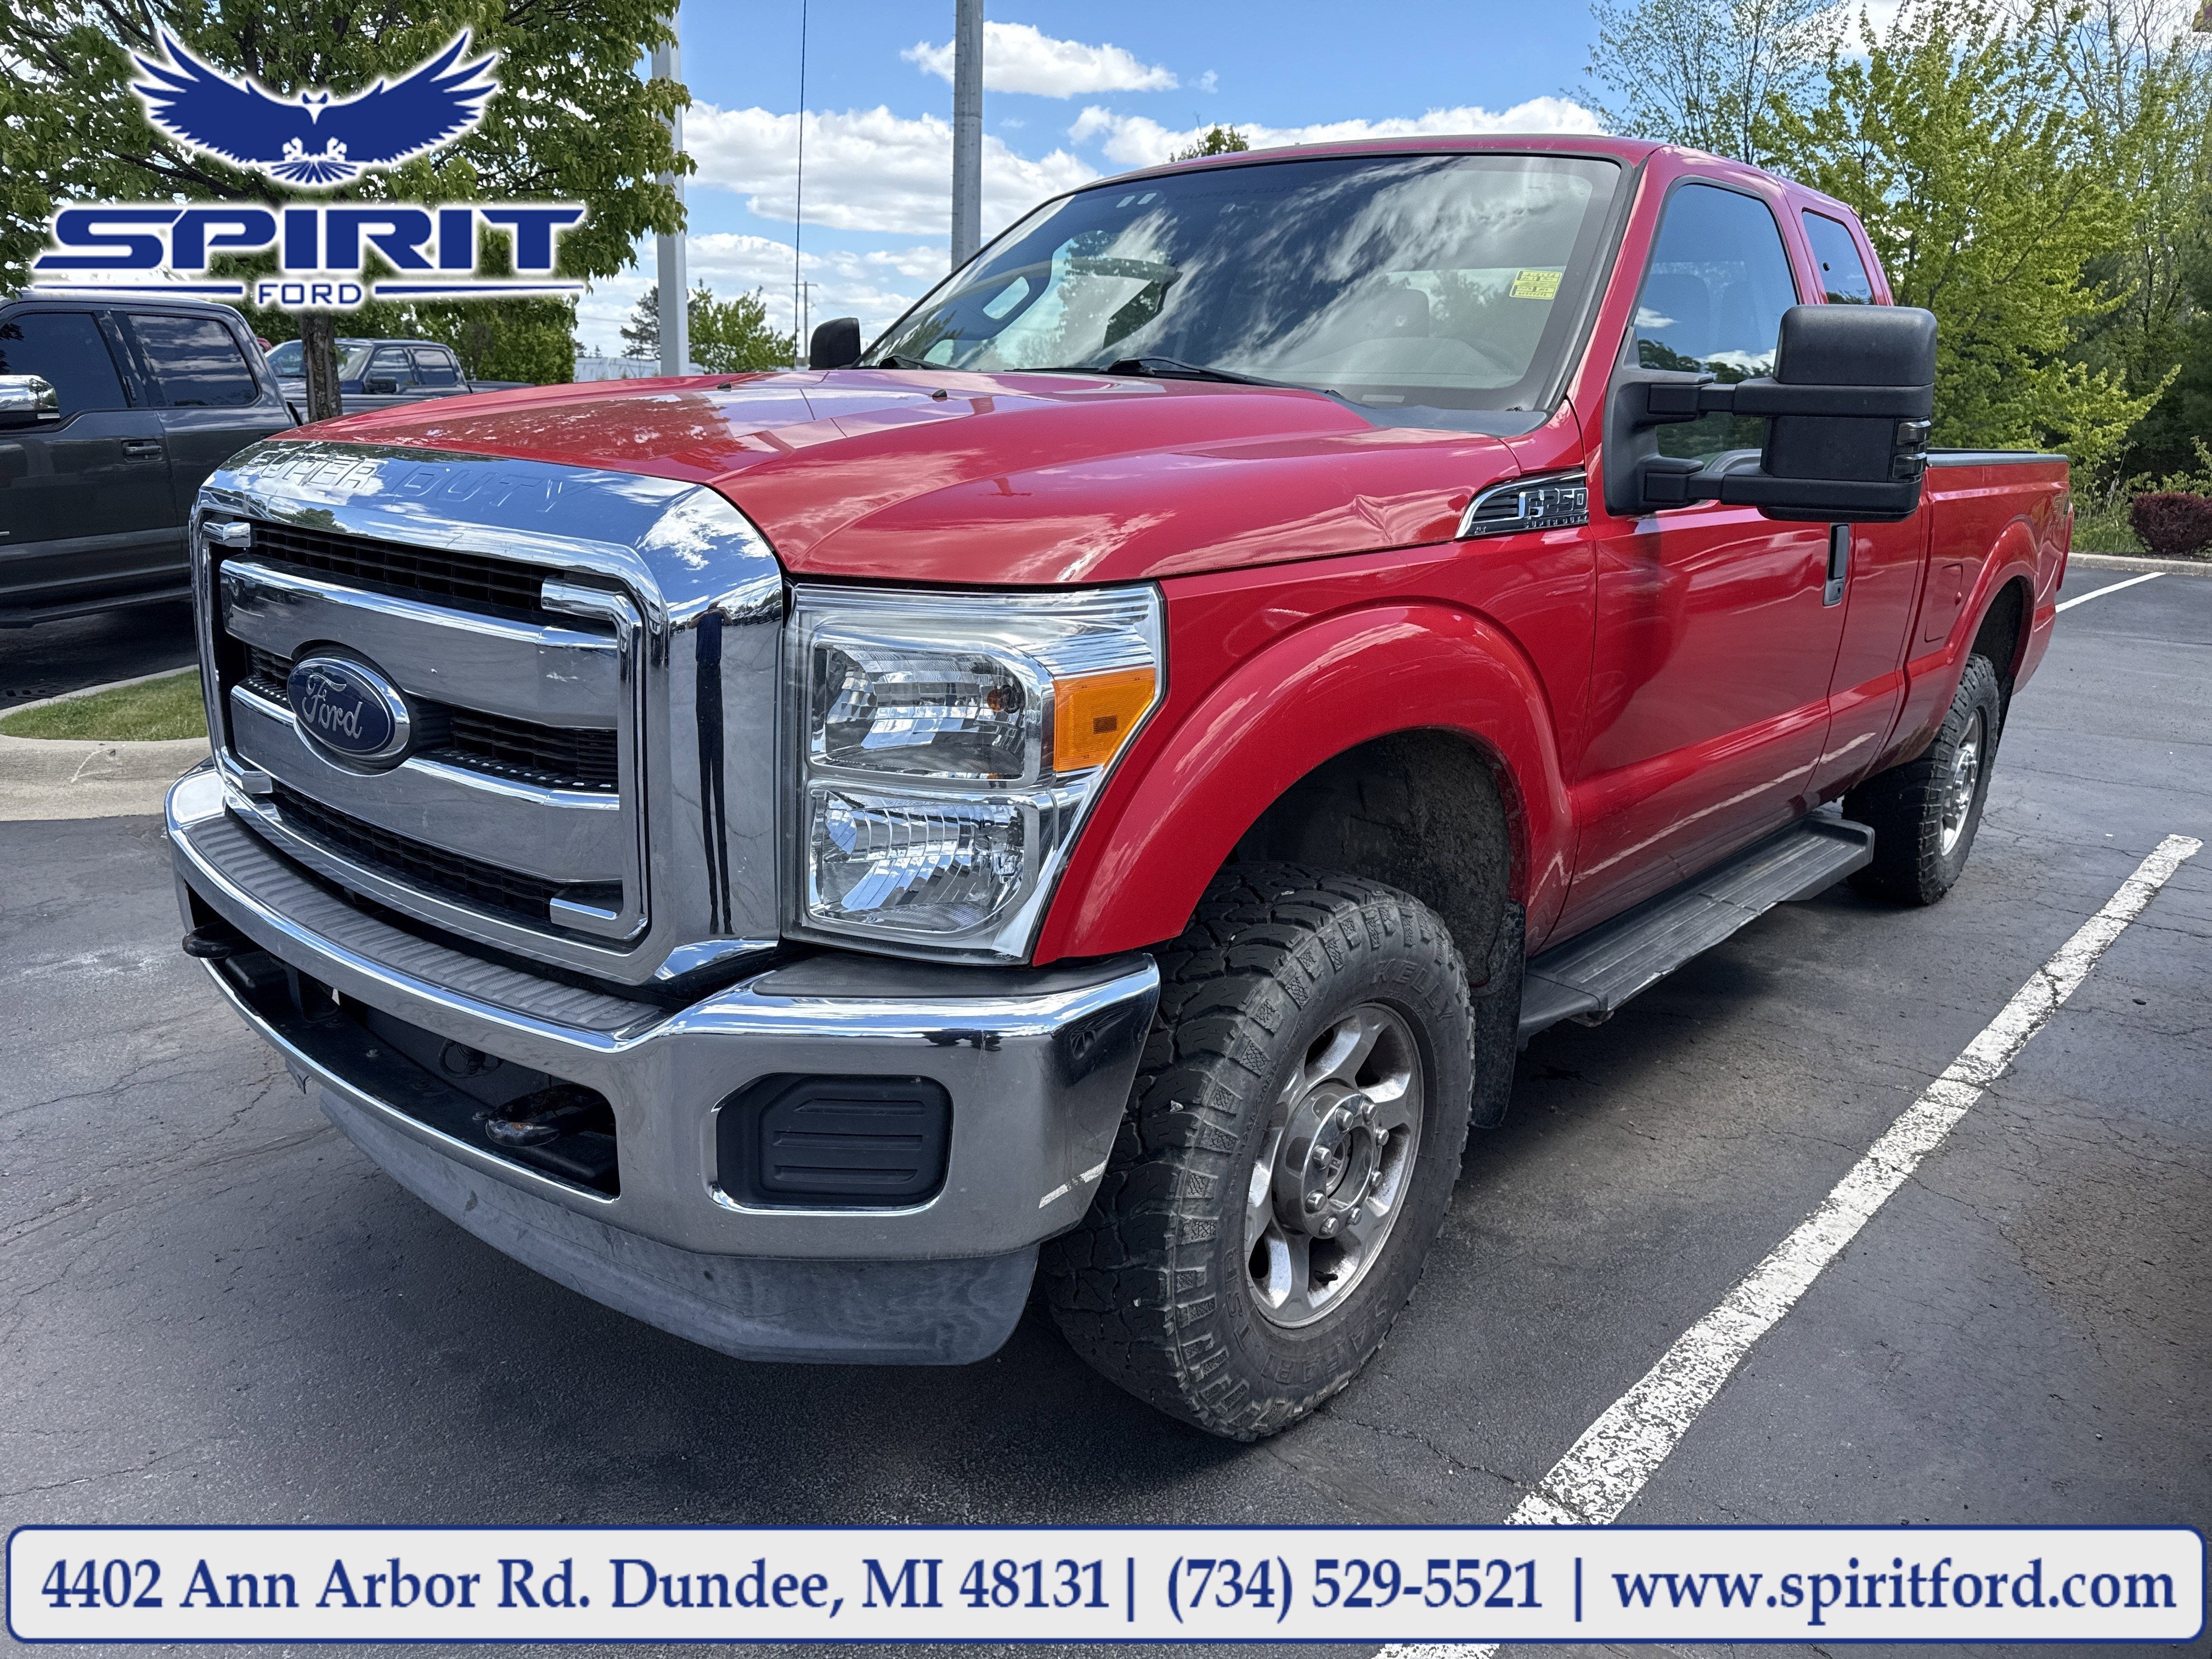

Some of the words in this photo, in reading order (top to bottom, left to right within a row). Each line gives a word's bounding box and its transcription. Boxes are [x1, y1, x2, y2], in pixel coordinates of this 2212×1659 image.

[237, 449, 389, 490] SUPER
[388, 464, 601, 514] DUTY
[302, 672, 364, 739] Ford
[1370, 958, 1455, 1022] KELLY
